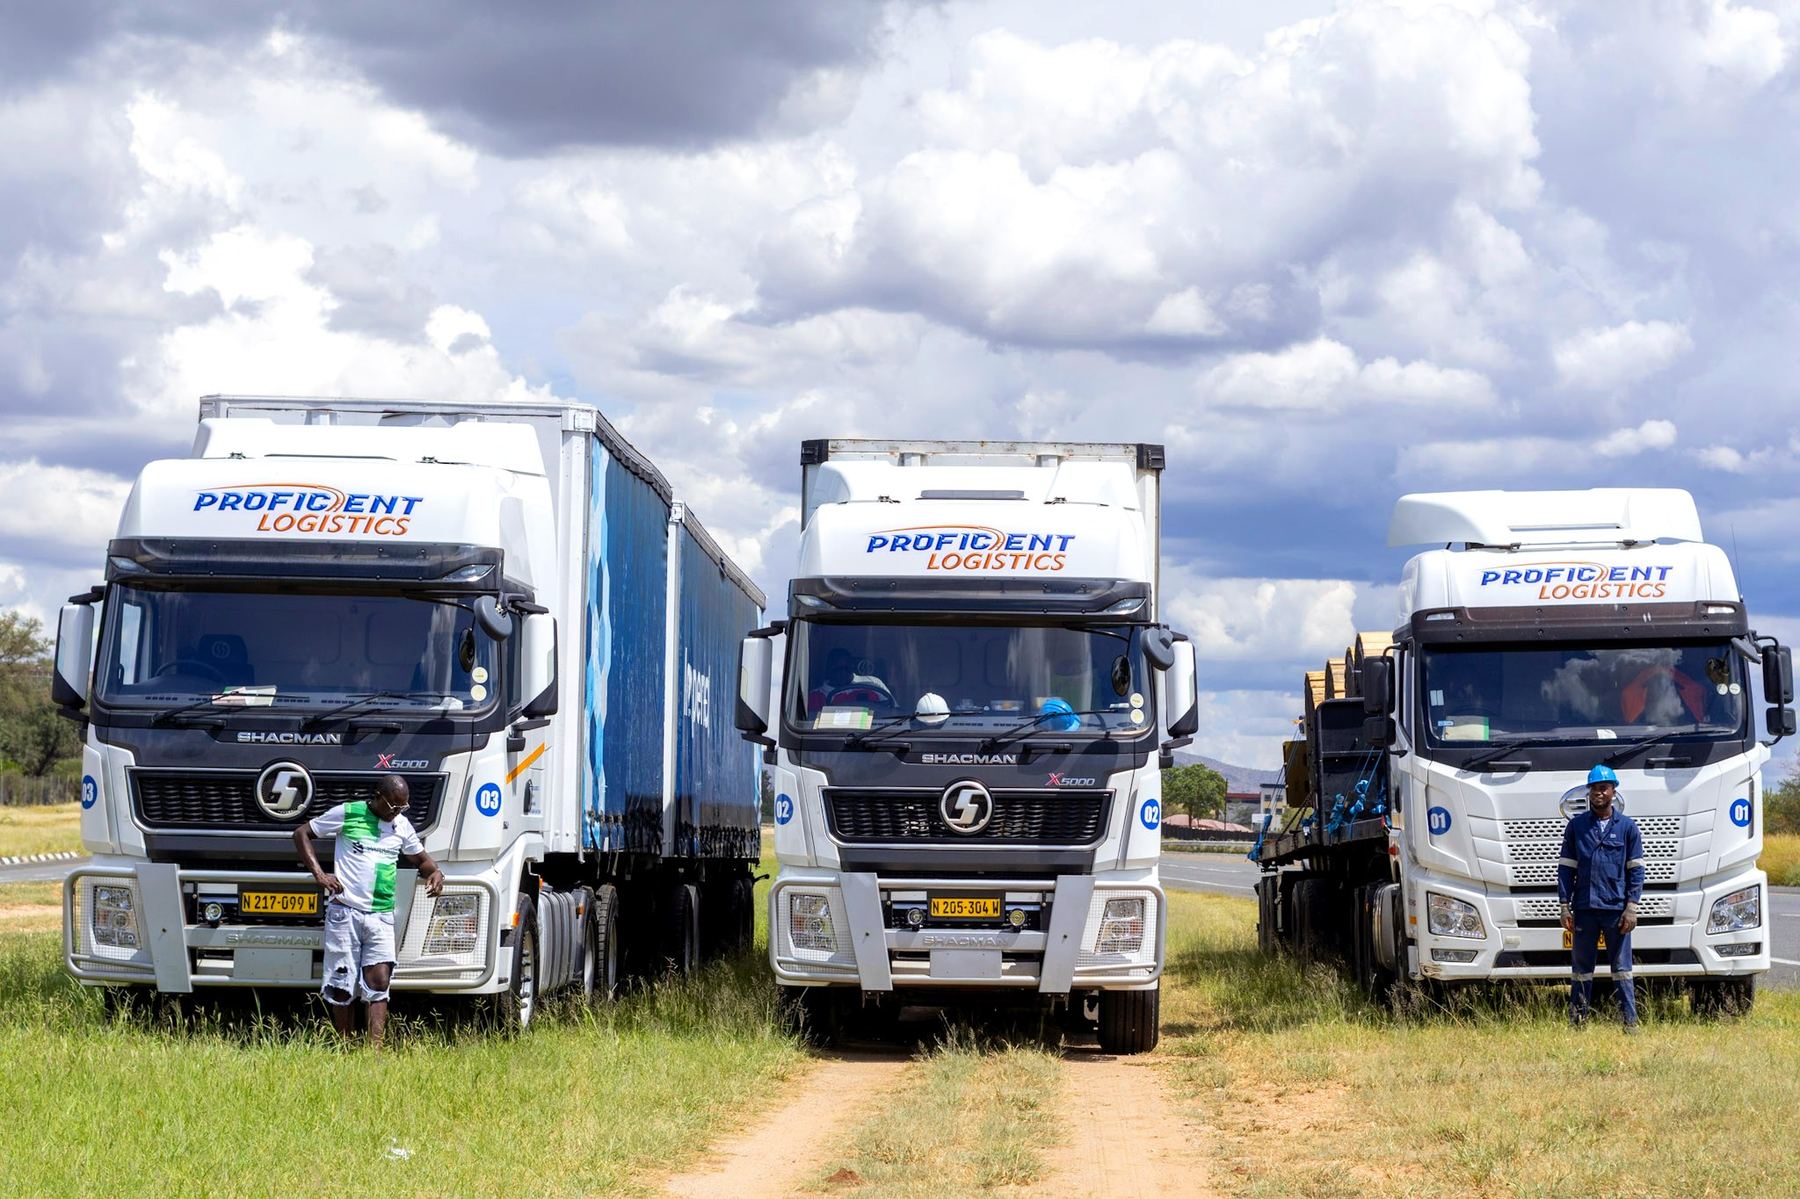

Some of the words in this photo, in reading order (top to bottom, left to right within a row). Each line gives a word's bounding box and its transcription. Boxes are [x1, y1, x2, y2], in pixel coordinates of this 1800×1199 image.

[256, 513, 411, 536] LOGISTICS
[926, 552, 1066, 571] LOGISTICS
[1538, 583, 1666, 600] LOGISTICS
[237, 731, 341, 744] SHACMAN
[373, 753, 430, 769] X5000
[922, 753, 1017, 765] SHACMAN
[1045, 772, 1096, 786] X5000
[82, 782, 94, 802] 03
[480, 789, 499, 810] 03
[776, 800, 790, 818] 02
[1144, 805, 1159, 823] 02
[1734, 804, 1749, 821] 01
[1430, 812, 1446, 829] 01
[243, 895, 251, 909] N
[254, 895, 304, 910] 217-099
[308, 896, 316, 910] W
[932, 901, 939, 914] N
[943, 901, 989, 914] 205-304
[992, 901, 999, 914] W
[226, 933, 320, 946] SHACMAN
